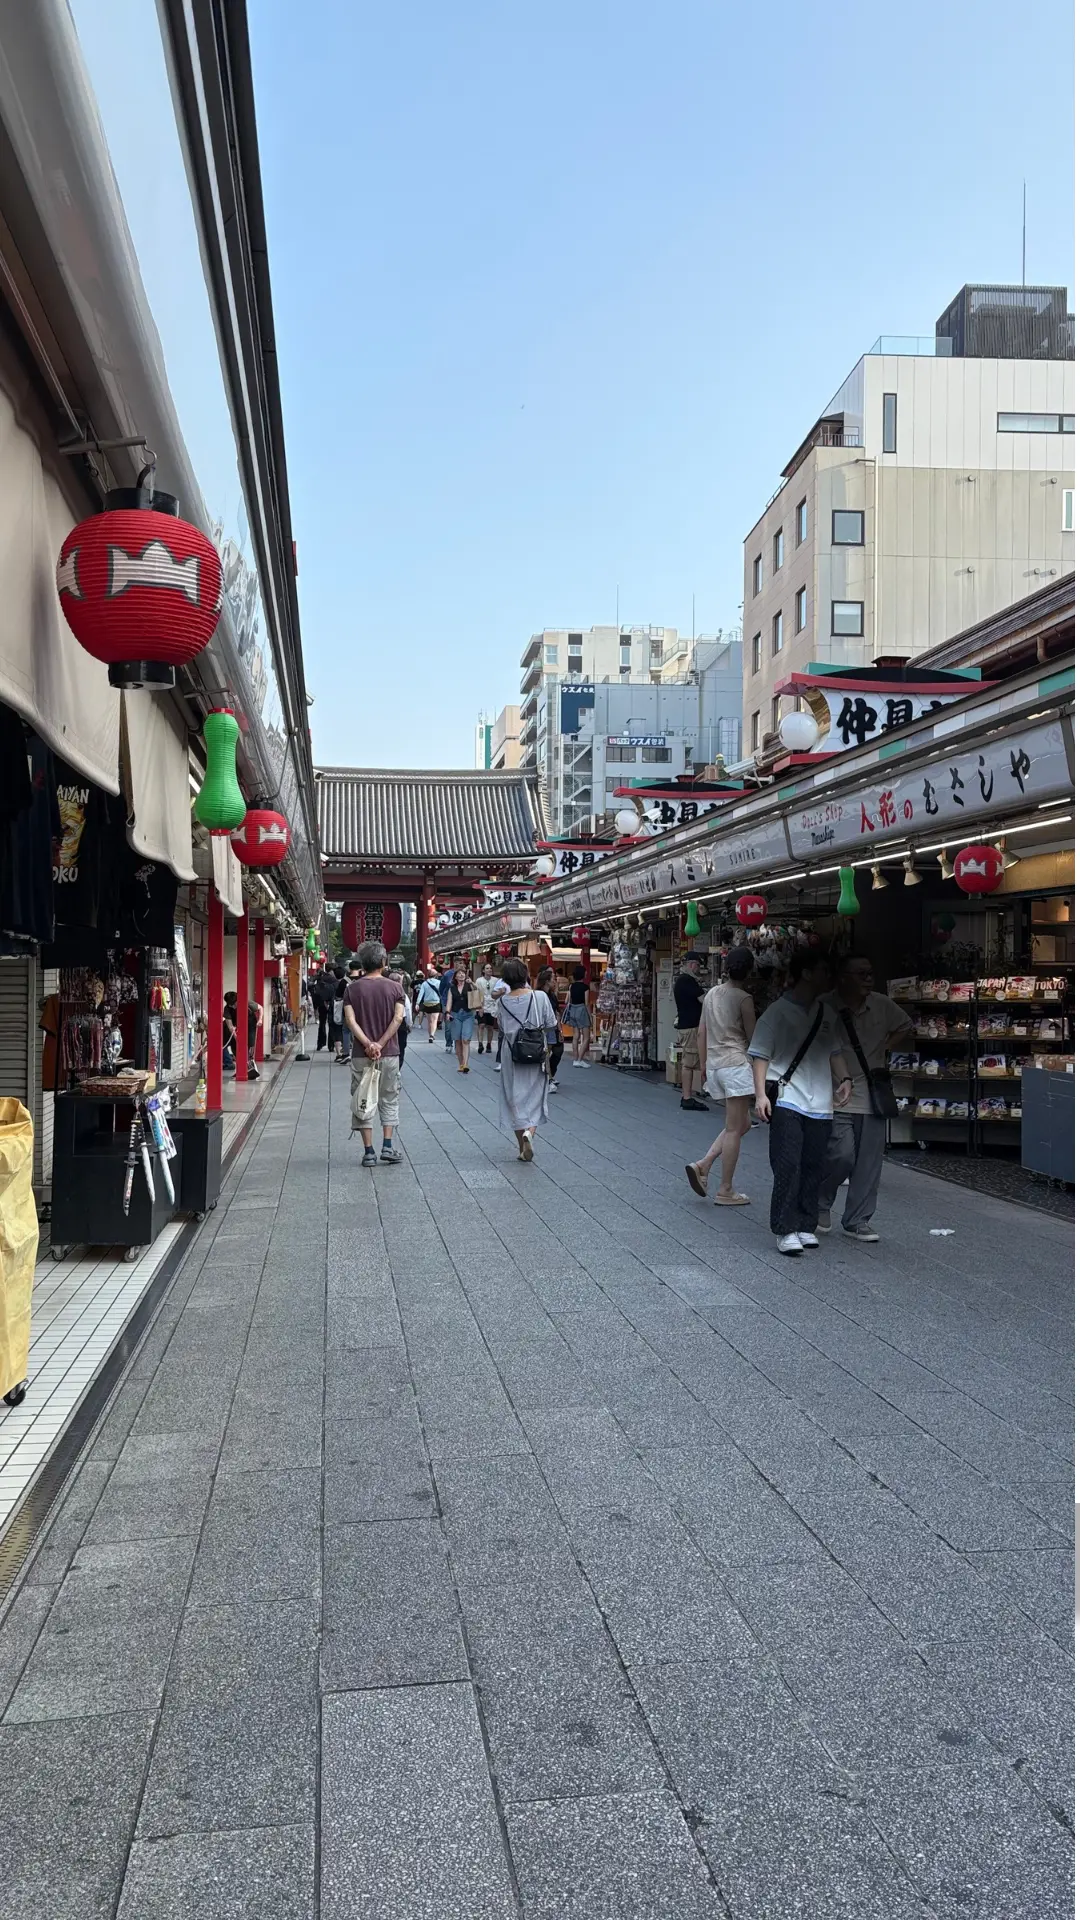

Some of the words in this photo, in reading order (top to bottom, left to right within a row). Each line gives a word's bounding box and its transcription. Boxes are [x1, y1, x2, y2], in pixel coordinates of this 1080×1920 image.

[56, 784, 90, 804] AIYAN
[859, 748, 1032, 833] 人形のむさしや
[668, 852, 715, 886] スミレ
[729, 848, 755, 865] SUMIRE
[364, 904, 384, 944] 風雷神
[976, 977, 1006, 988] JAPAN
[1035, 980, 1065, 990] TOKYO
